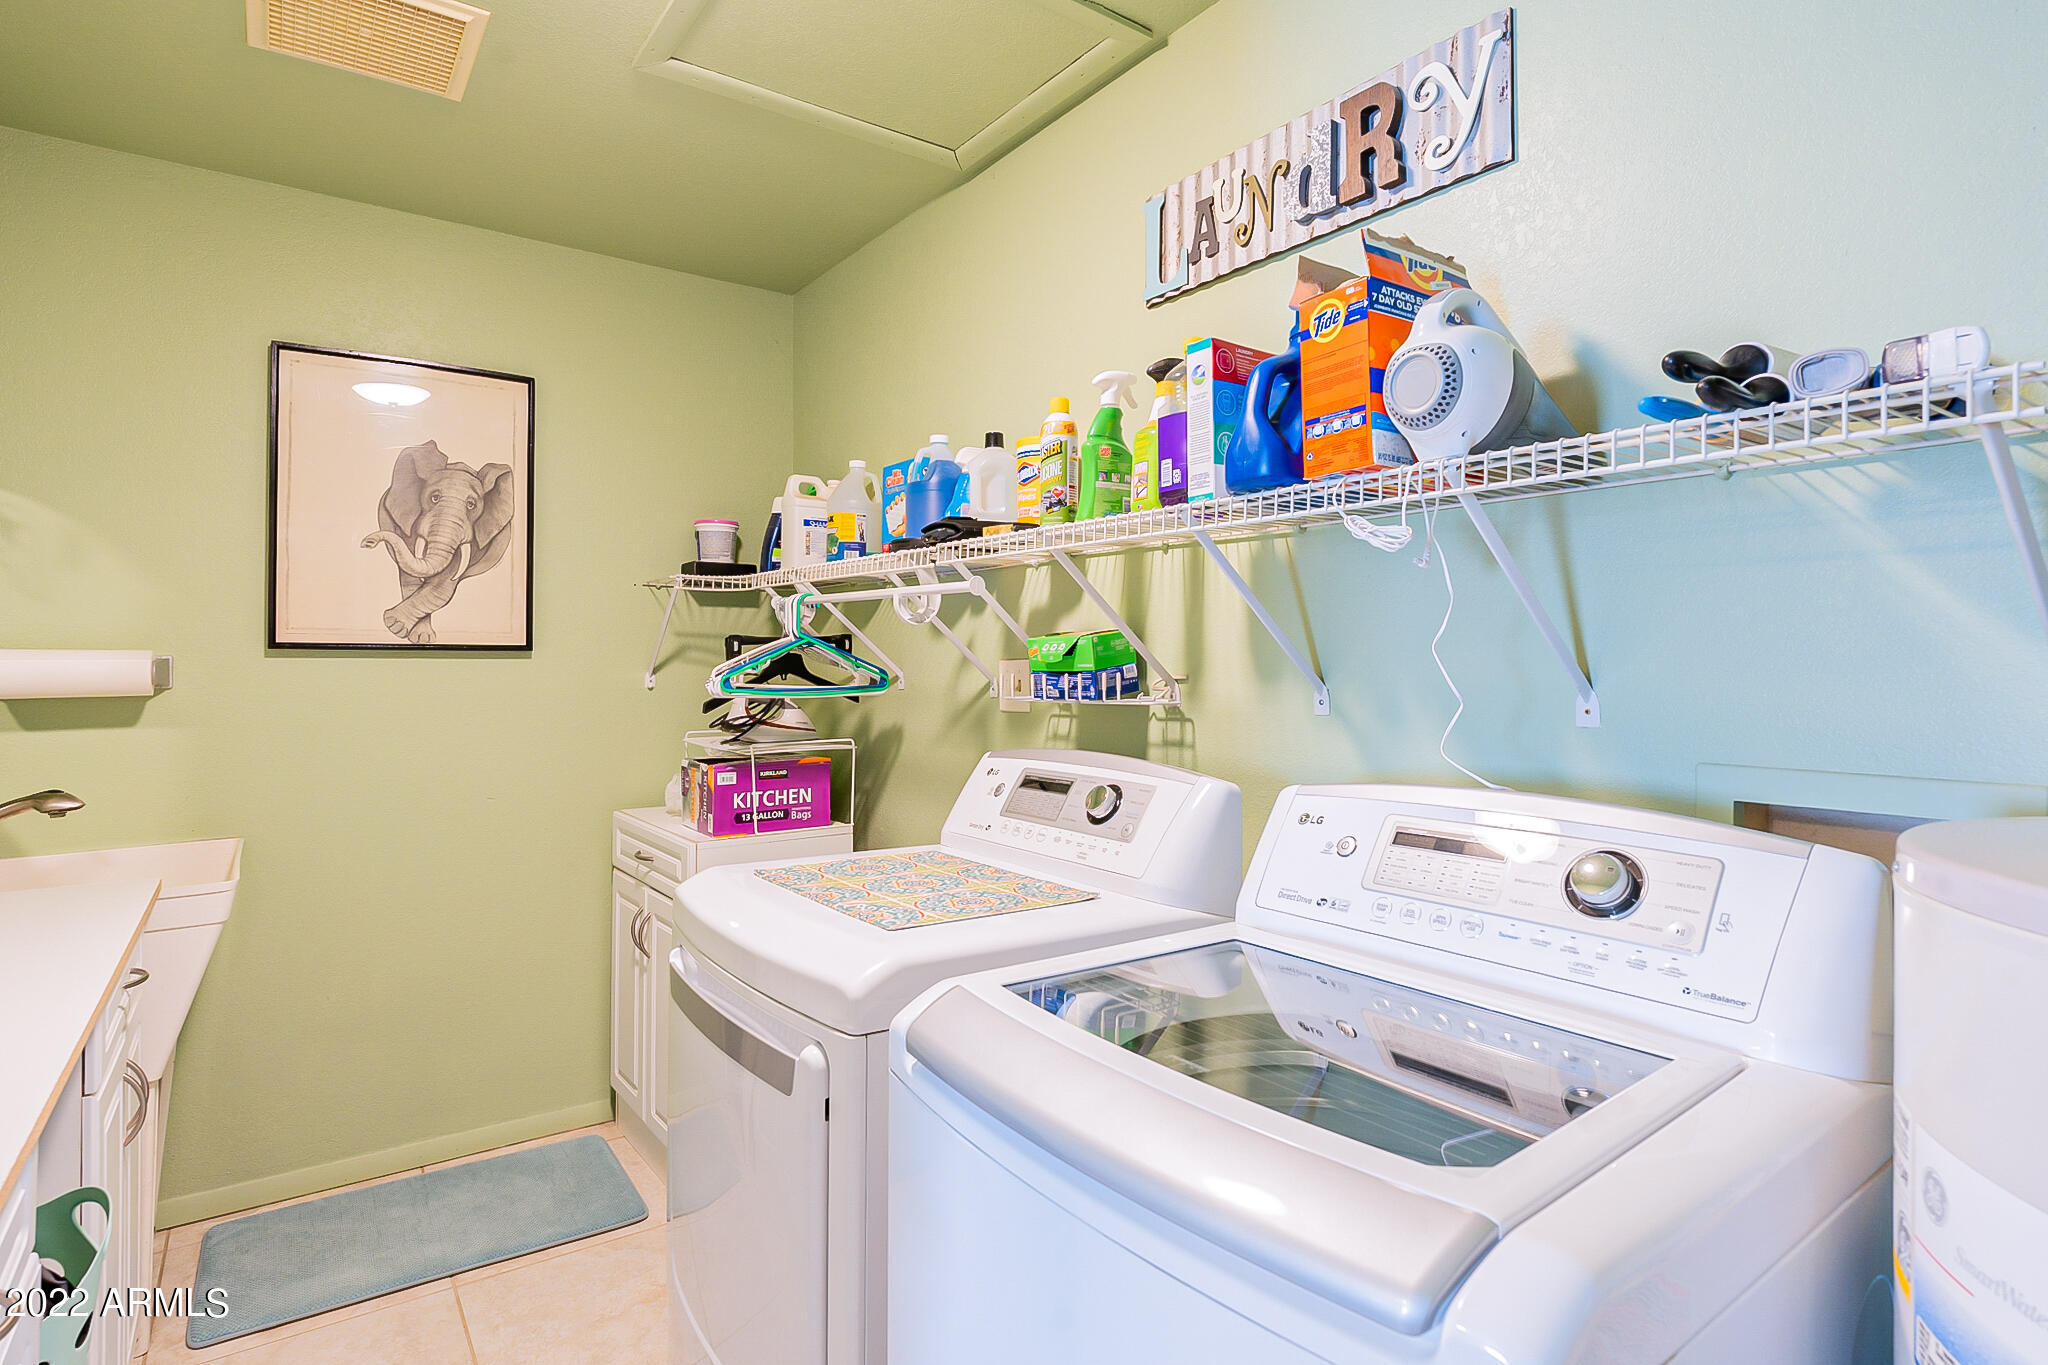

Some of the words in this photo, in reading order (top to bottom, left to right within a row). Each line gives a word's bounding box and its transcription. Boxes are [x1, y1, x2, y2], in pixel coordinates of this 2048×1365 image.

[1371, 291, 1377, 301] 7
[1378, 293, 1395, 306] DAY
[1396, 299, 1412, 312] OLD
[1381, 285, 1415, 304] ATTACKS
[1312, 307, 1342, 340] Tide
[733, 787, 812, 809] KITCHEN
[741, 813, 751, 822] 13
[752, 810, 784, 820] GALLON
[791, 810, 812, 821] Bags
[1692, 989, 1748, 1008] TrueBalance
[1956, 1244, 2048, 1331] SmartWate
